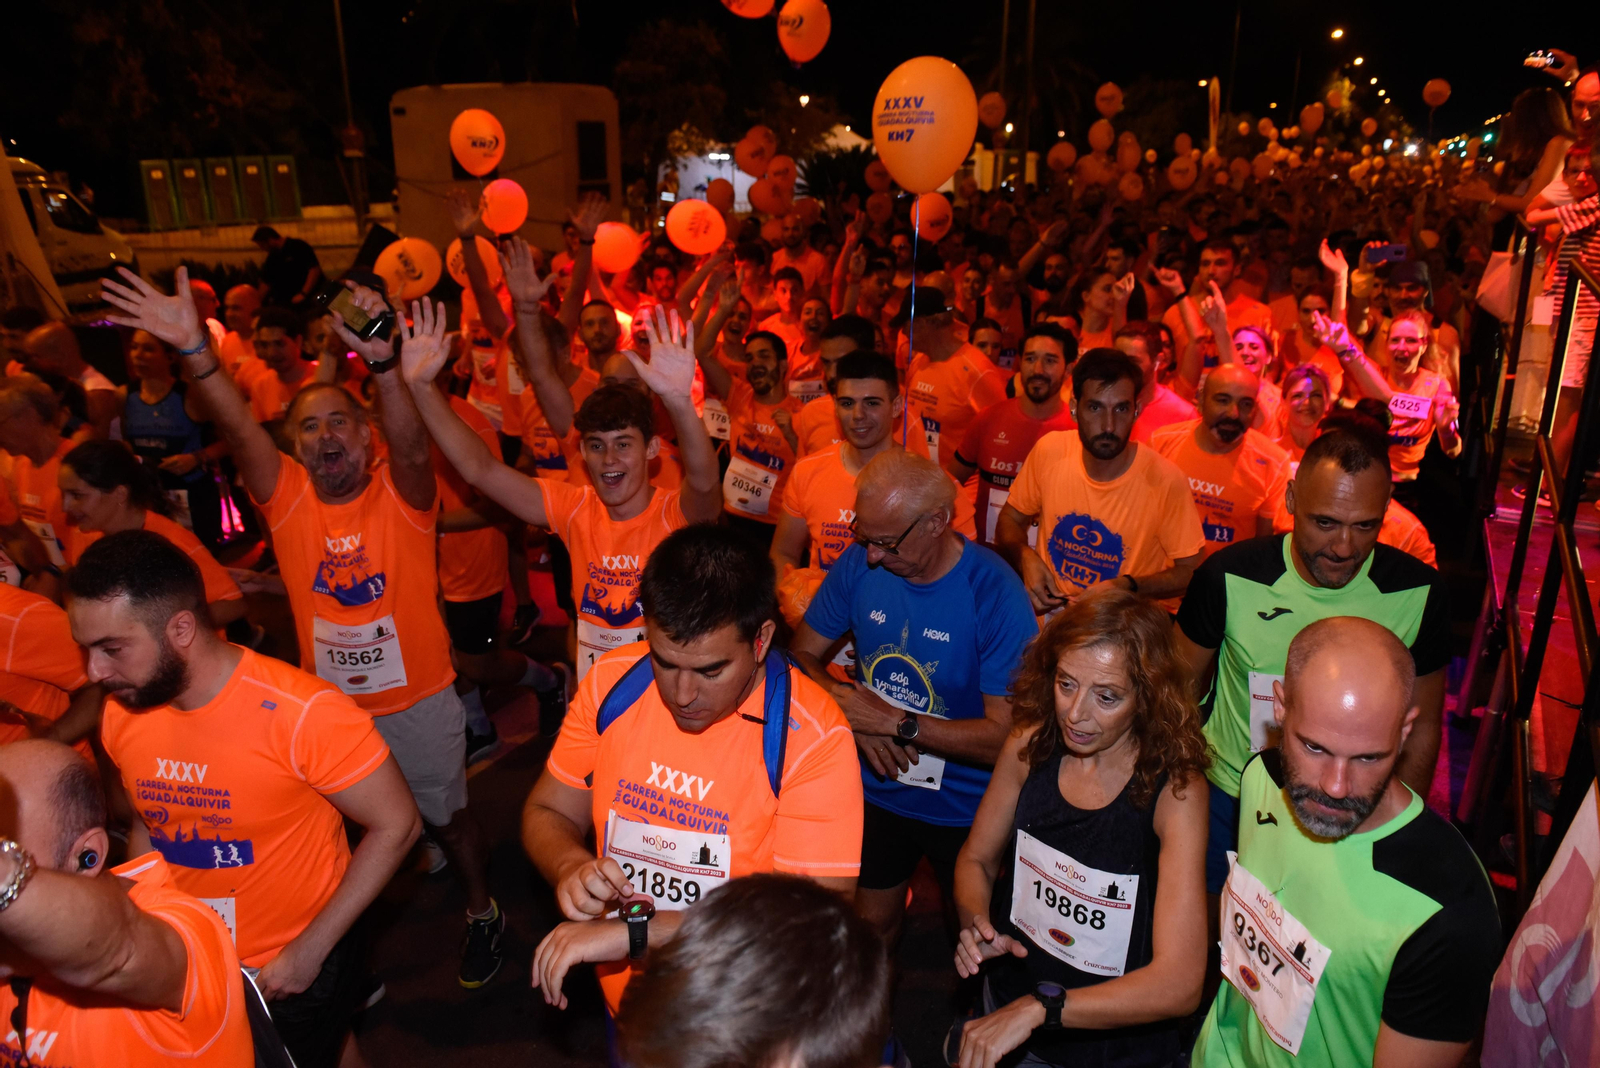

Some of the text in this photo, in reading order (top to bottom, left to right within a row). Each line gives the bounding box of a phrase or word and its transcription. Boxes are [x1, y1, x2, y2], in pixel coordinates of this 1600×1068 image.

[884, 96, 924, 110] XXXV
[1391, 398, 1420, 412] 4525
[710, 411, 731, 424] 178
[990, 457, 1013, 472] Los
[731, 476, 762, 498] 20346
[992, 475, 1009, 486] CLUB
[1188, 477, 1225, 496] XXXV
[822, 522, 848, 531] CARRER
[1064, 541, 1119, 563] NOCTURNA
[602, 554, 640, 570] XXXV
[581, 606, 596, 615] 2023
[870, 609, 887, 625] edp
[923, 627, 950, 643] HOKA
[326, 647, 385, 667] 13562
[889, 671, 910, 687] edp
[885, 681, 921, 701] maratón
[156, 757, 208, 784] XXXV
[136, 778, 231, 798] CARRERA NOCTURNA
[645, 761, 714, 802] XXXV
[141, 789, 232, 810] GUADALQUIVIR
[618, 779, 730, 822] CARRERA NOCTURNA
[622, 793, 728, 836] GUADALQUIVIR
[666, 862, 700, 874] GUADALQUIVIR
[622, 862, 701, 906] 21859
[1033, 880, 1106, 931] 19868
[1234, 912, 1285, 977] 9367
[1083, 960, 1119, 972] Cruzcampo
